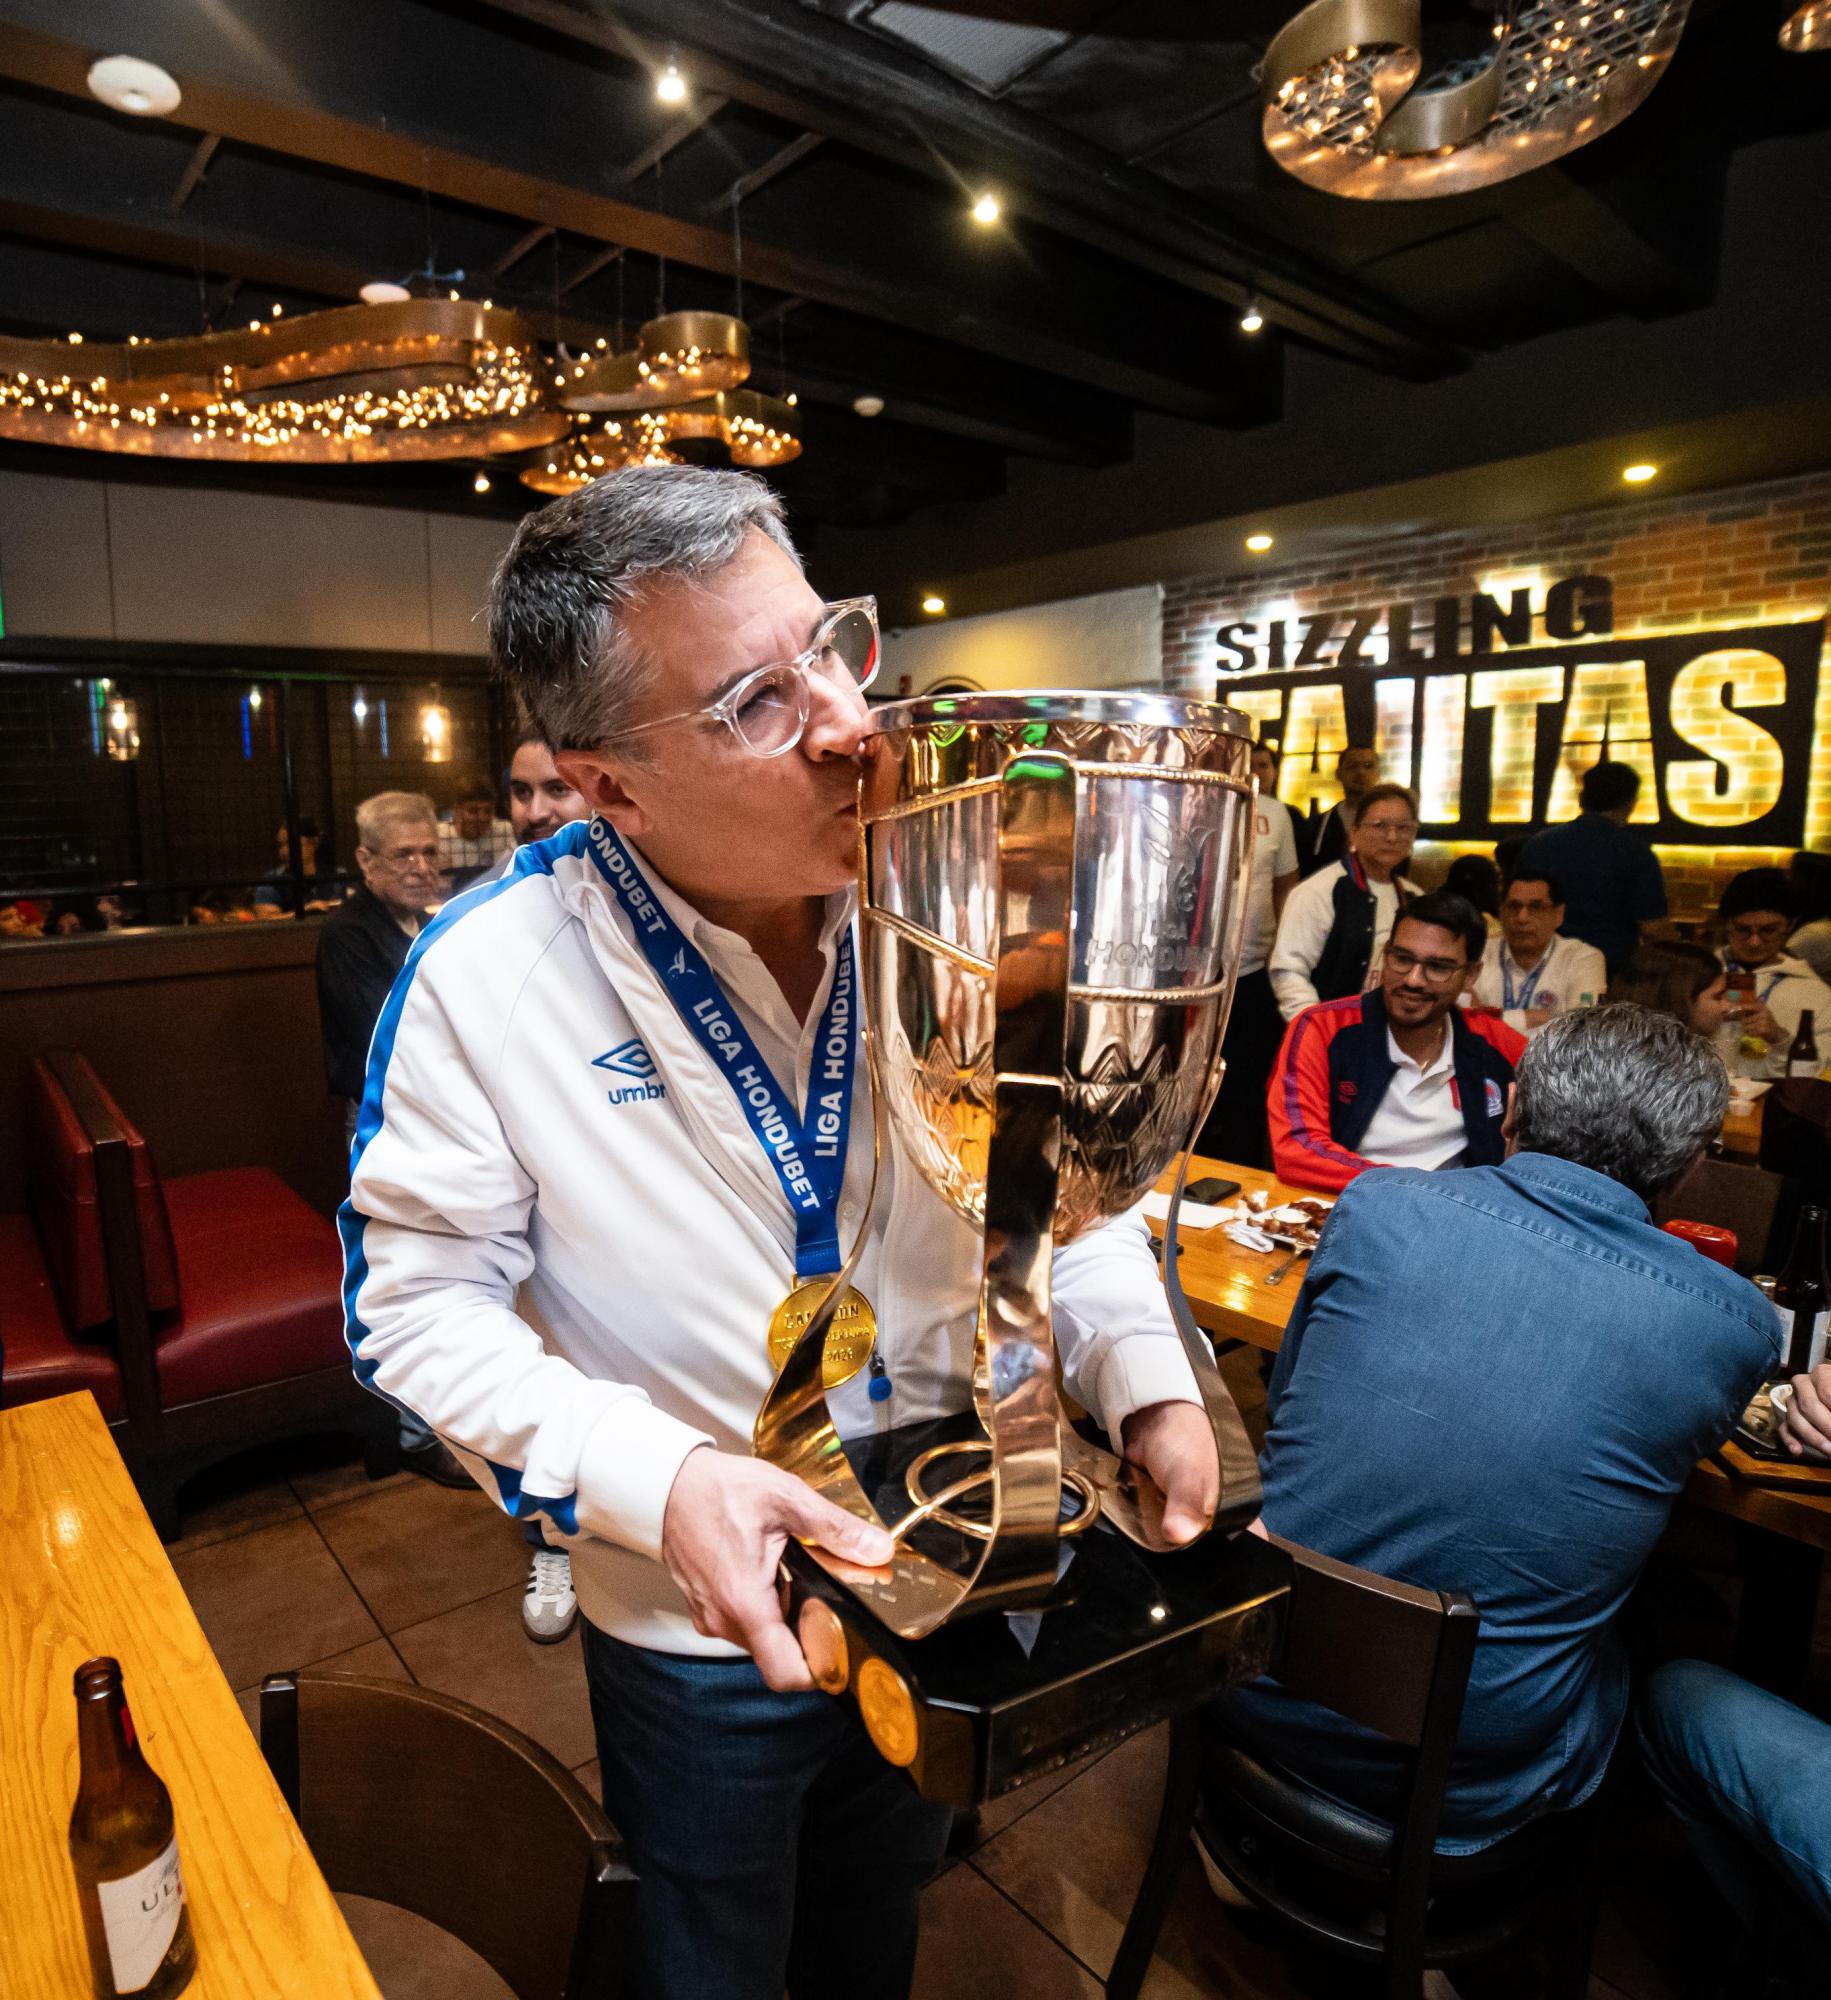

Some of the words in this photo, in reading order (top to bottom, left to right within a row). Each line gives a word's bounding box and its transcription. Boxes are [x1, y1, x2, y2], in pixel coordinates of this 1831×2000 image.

[1216, 575, 1613, 672] SIZZLING
[1226, 647, 1787, 827] AJITAS
[823, 930, 851, 1080] HONDUBE
[608, 1080, 666, 1105] umbr
[692, 998, 743, 1062] LIGA
[735, 1064, 821, 1209] HONDUBET
[814, 1090, 843, 1157] LIGA
